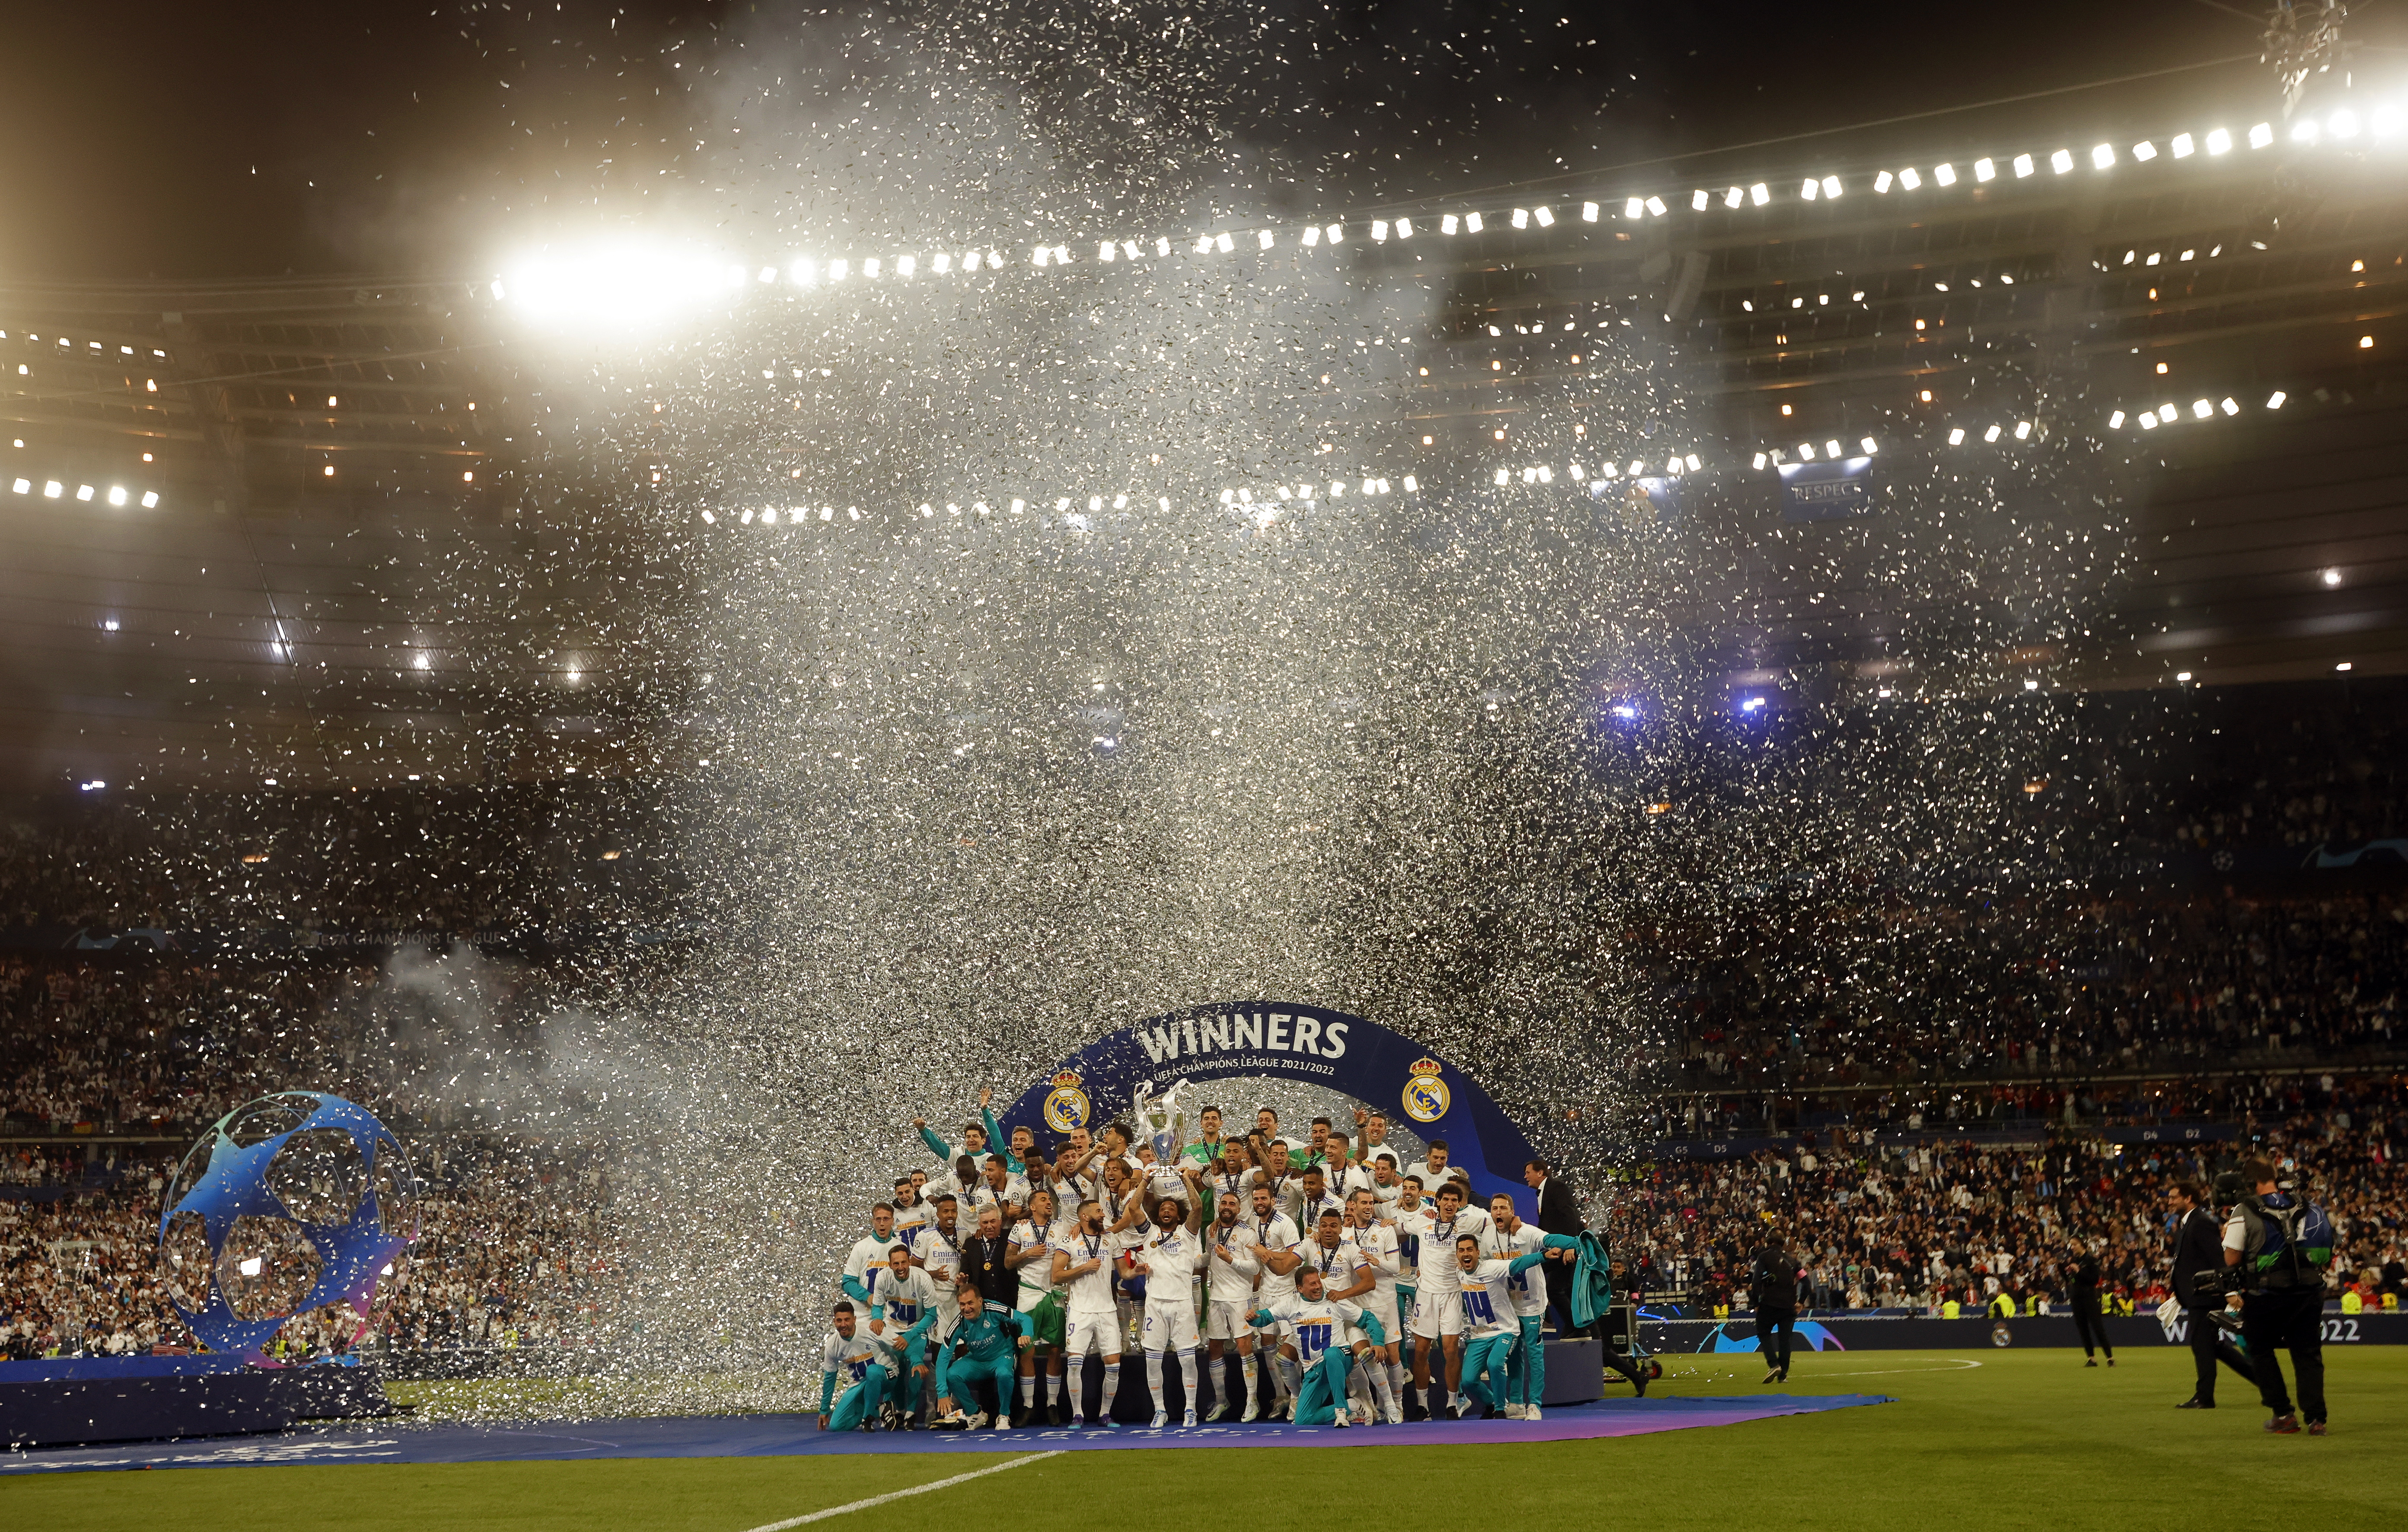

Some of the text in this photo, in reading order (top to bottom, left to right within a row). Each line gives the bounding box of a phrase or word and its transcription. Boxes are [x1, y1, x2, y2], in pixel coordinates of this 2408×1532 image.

[1137, 1013, 1349, 1064] WINNERS
[1154, 1058, 1335, 1081] UEFA CHAMPIONS LEAGUE 2021/2022
[1714, 1144, 1727, 1153] D5
[1463, 1291, 1497, 1326] 14
[1143, 1317, 1153, 1331] 12
[1296, 1316, 1332, 1325] CHAMPIONS
[1067, 1323, 1075, 1337] 9
[1297, 1324, 1331, 1360] 14
